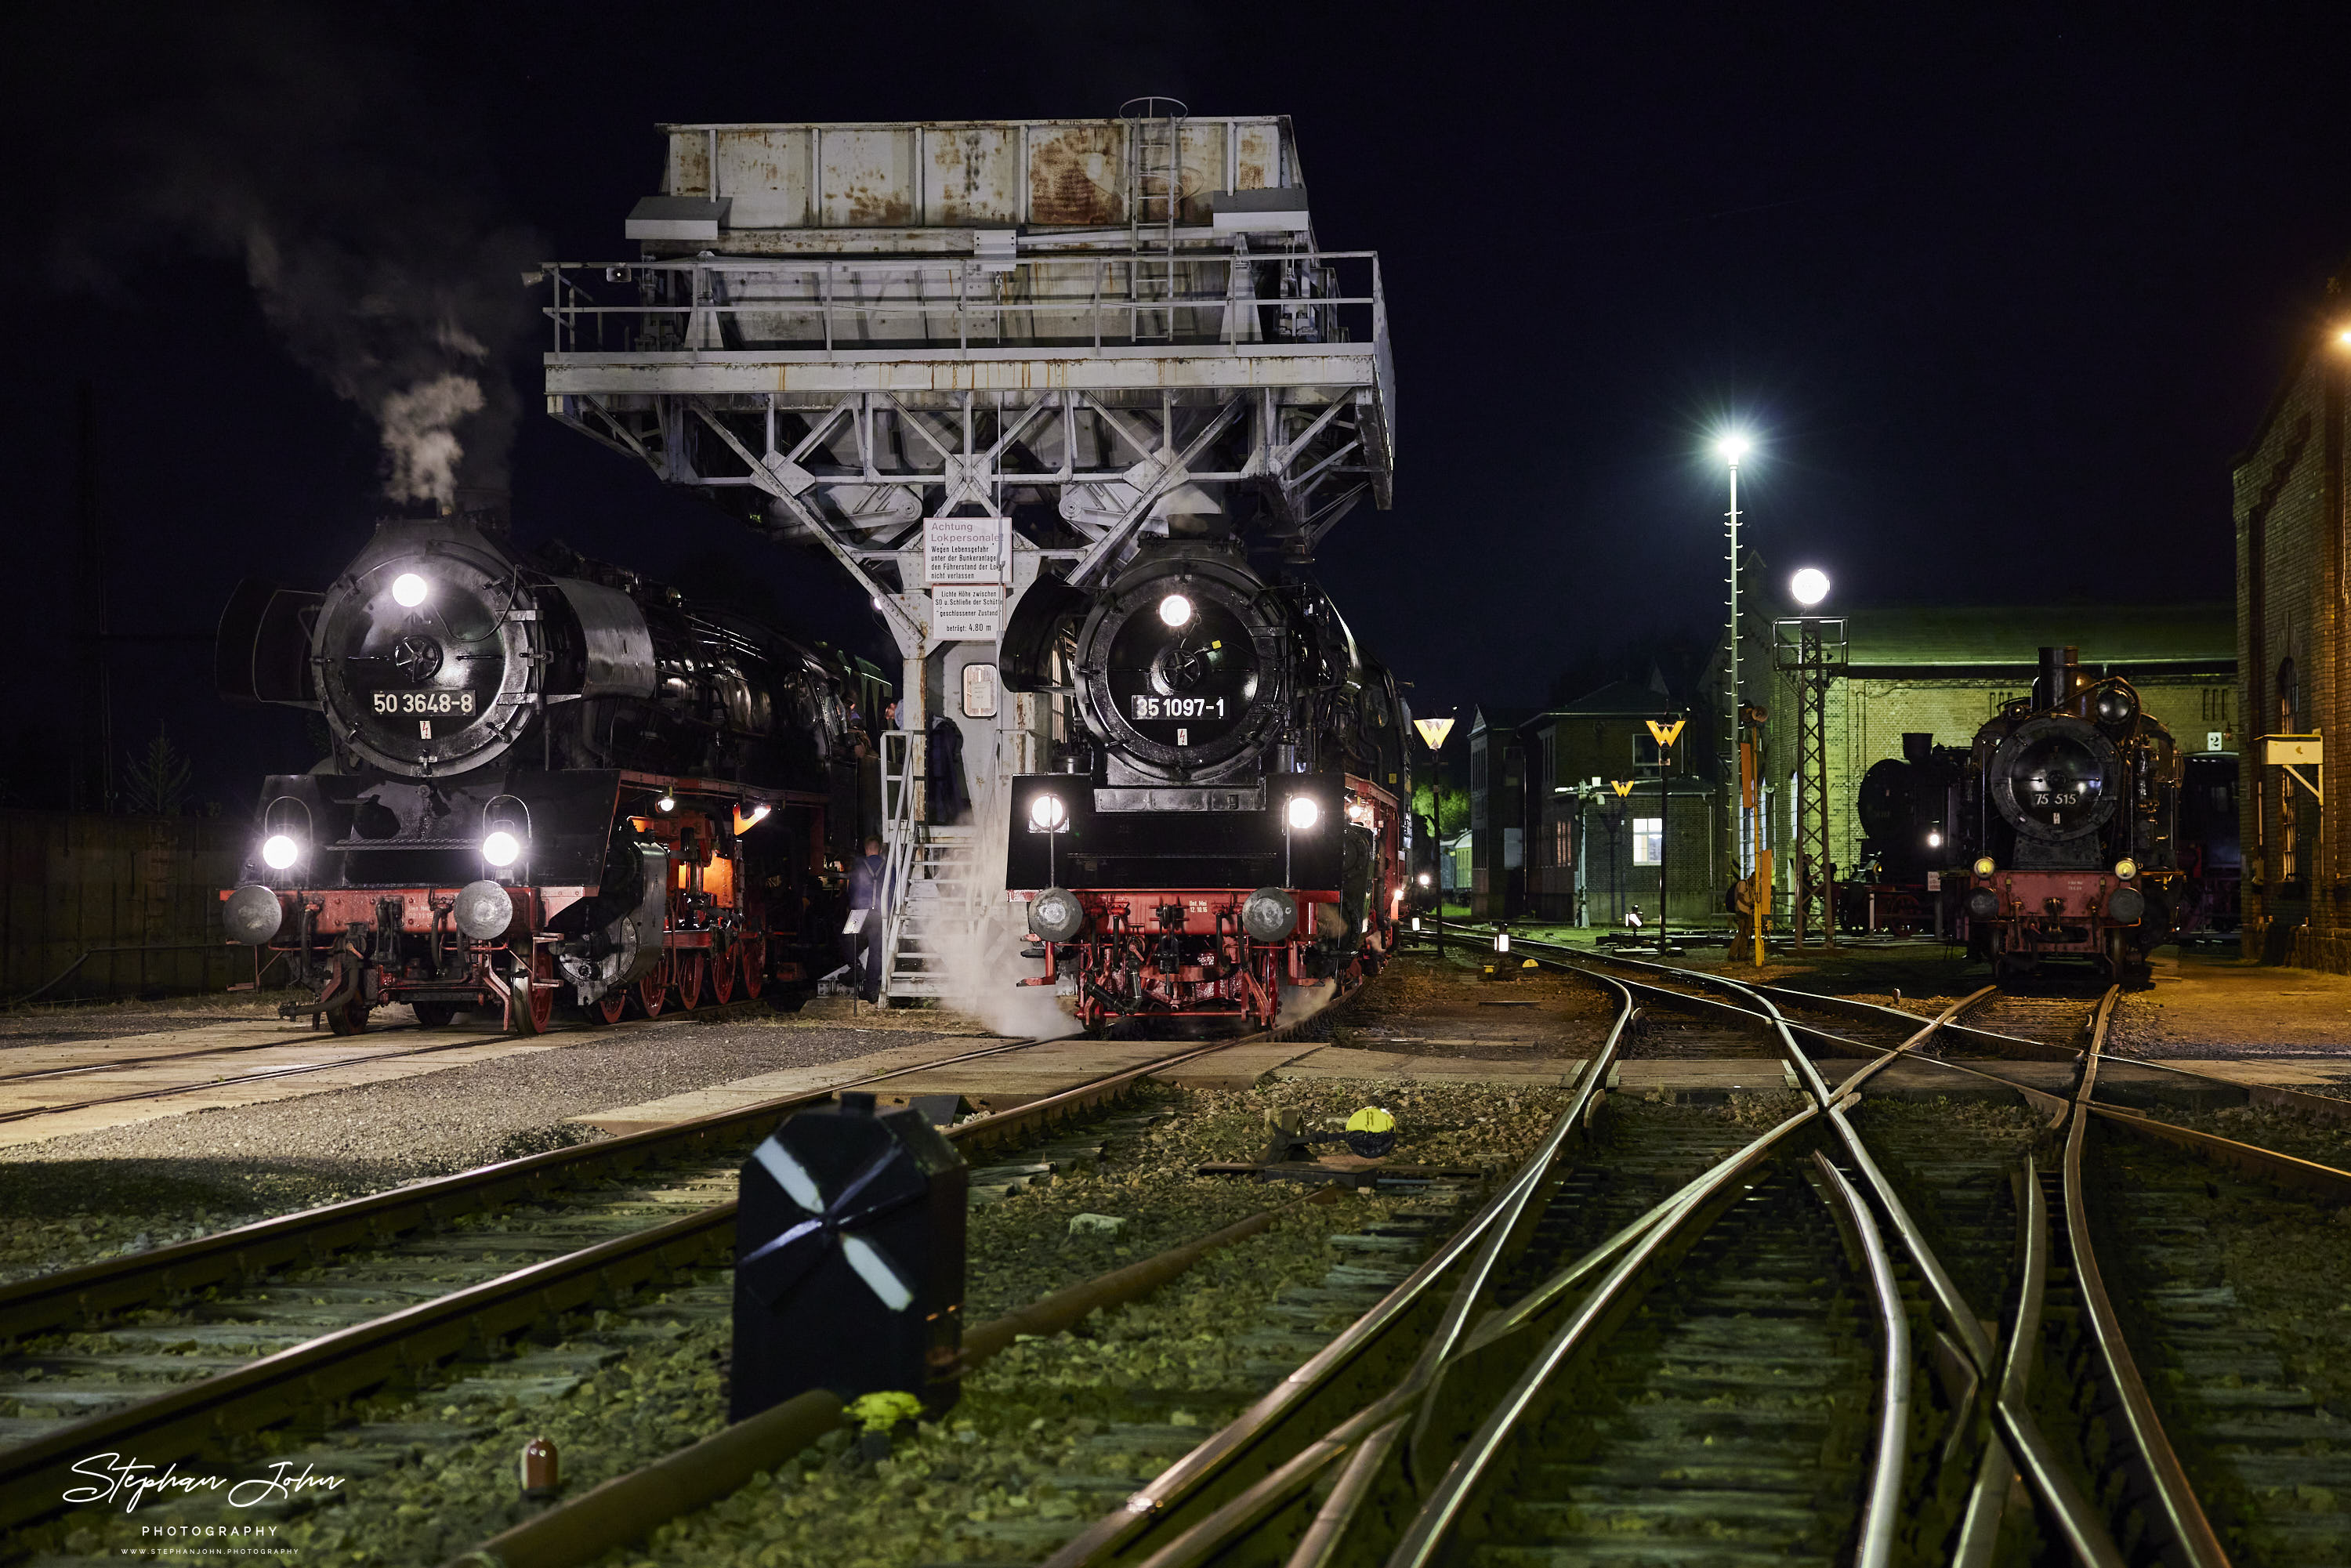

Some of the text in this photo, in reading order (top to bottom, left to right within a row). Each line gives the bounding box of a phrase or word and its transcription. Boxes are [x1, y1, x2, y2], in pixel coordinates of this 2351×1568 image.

[932, 522, 973, 533] Achtung
[931, 545, 989, 554] Wegen Lebensgefahr
[959, 554, 997, 563] Bunkeranlage
[969, 623, 984, 632] 4.80
[373, 693, 473, 712] 50 3648-8
[1136, 698, 1224, 717] 35 1097-1
[1646, 720, 1686, 747] W
[1610, 780, 1635, 797] W
[2035, 794, 2077, 805] 75 515
